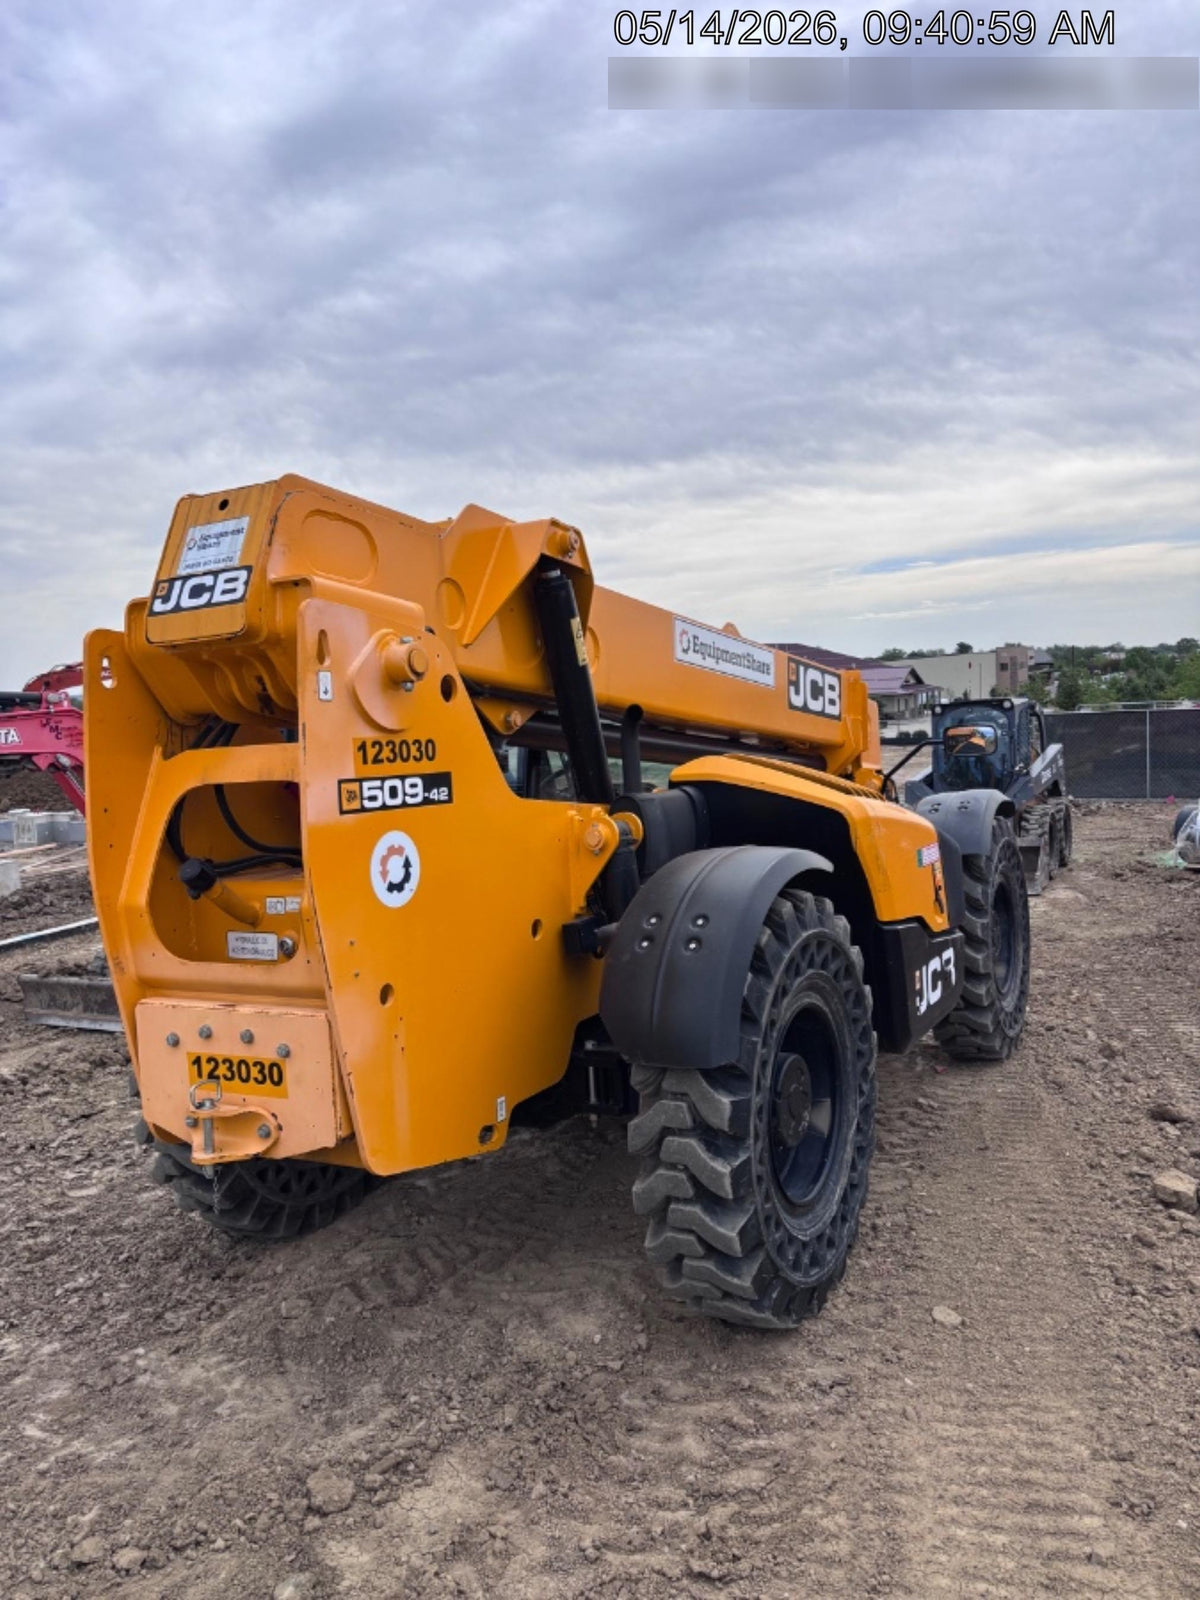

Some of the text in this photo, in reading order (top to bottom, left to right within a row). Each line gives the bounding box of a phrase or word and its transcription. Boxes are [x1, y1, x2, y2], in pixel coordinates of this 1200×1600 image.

[152, 570, 248, 612] JCB
[692, 634, 771, 675] EquipmentShare
[789, 664, 840, 717] JCB
[357, 738, 437, 765] 123030
[361, 776, 449, 809] 509-42
[191, 1055, 284, 1087] 123030
